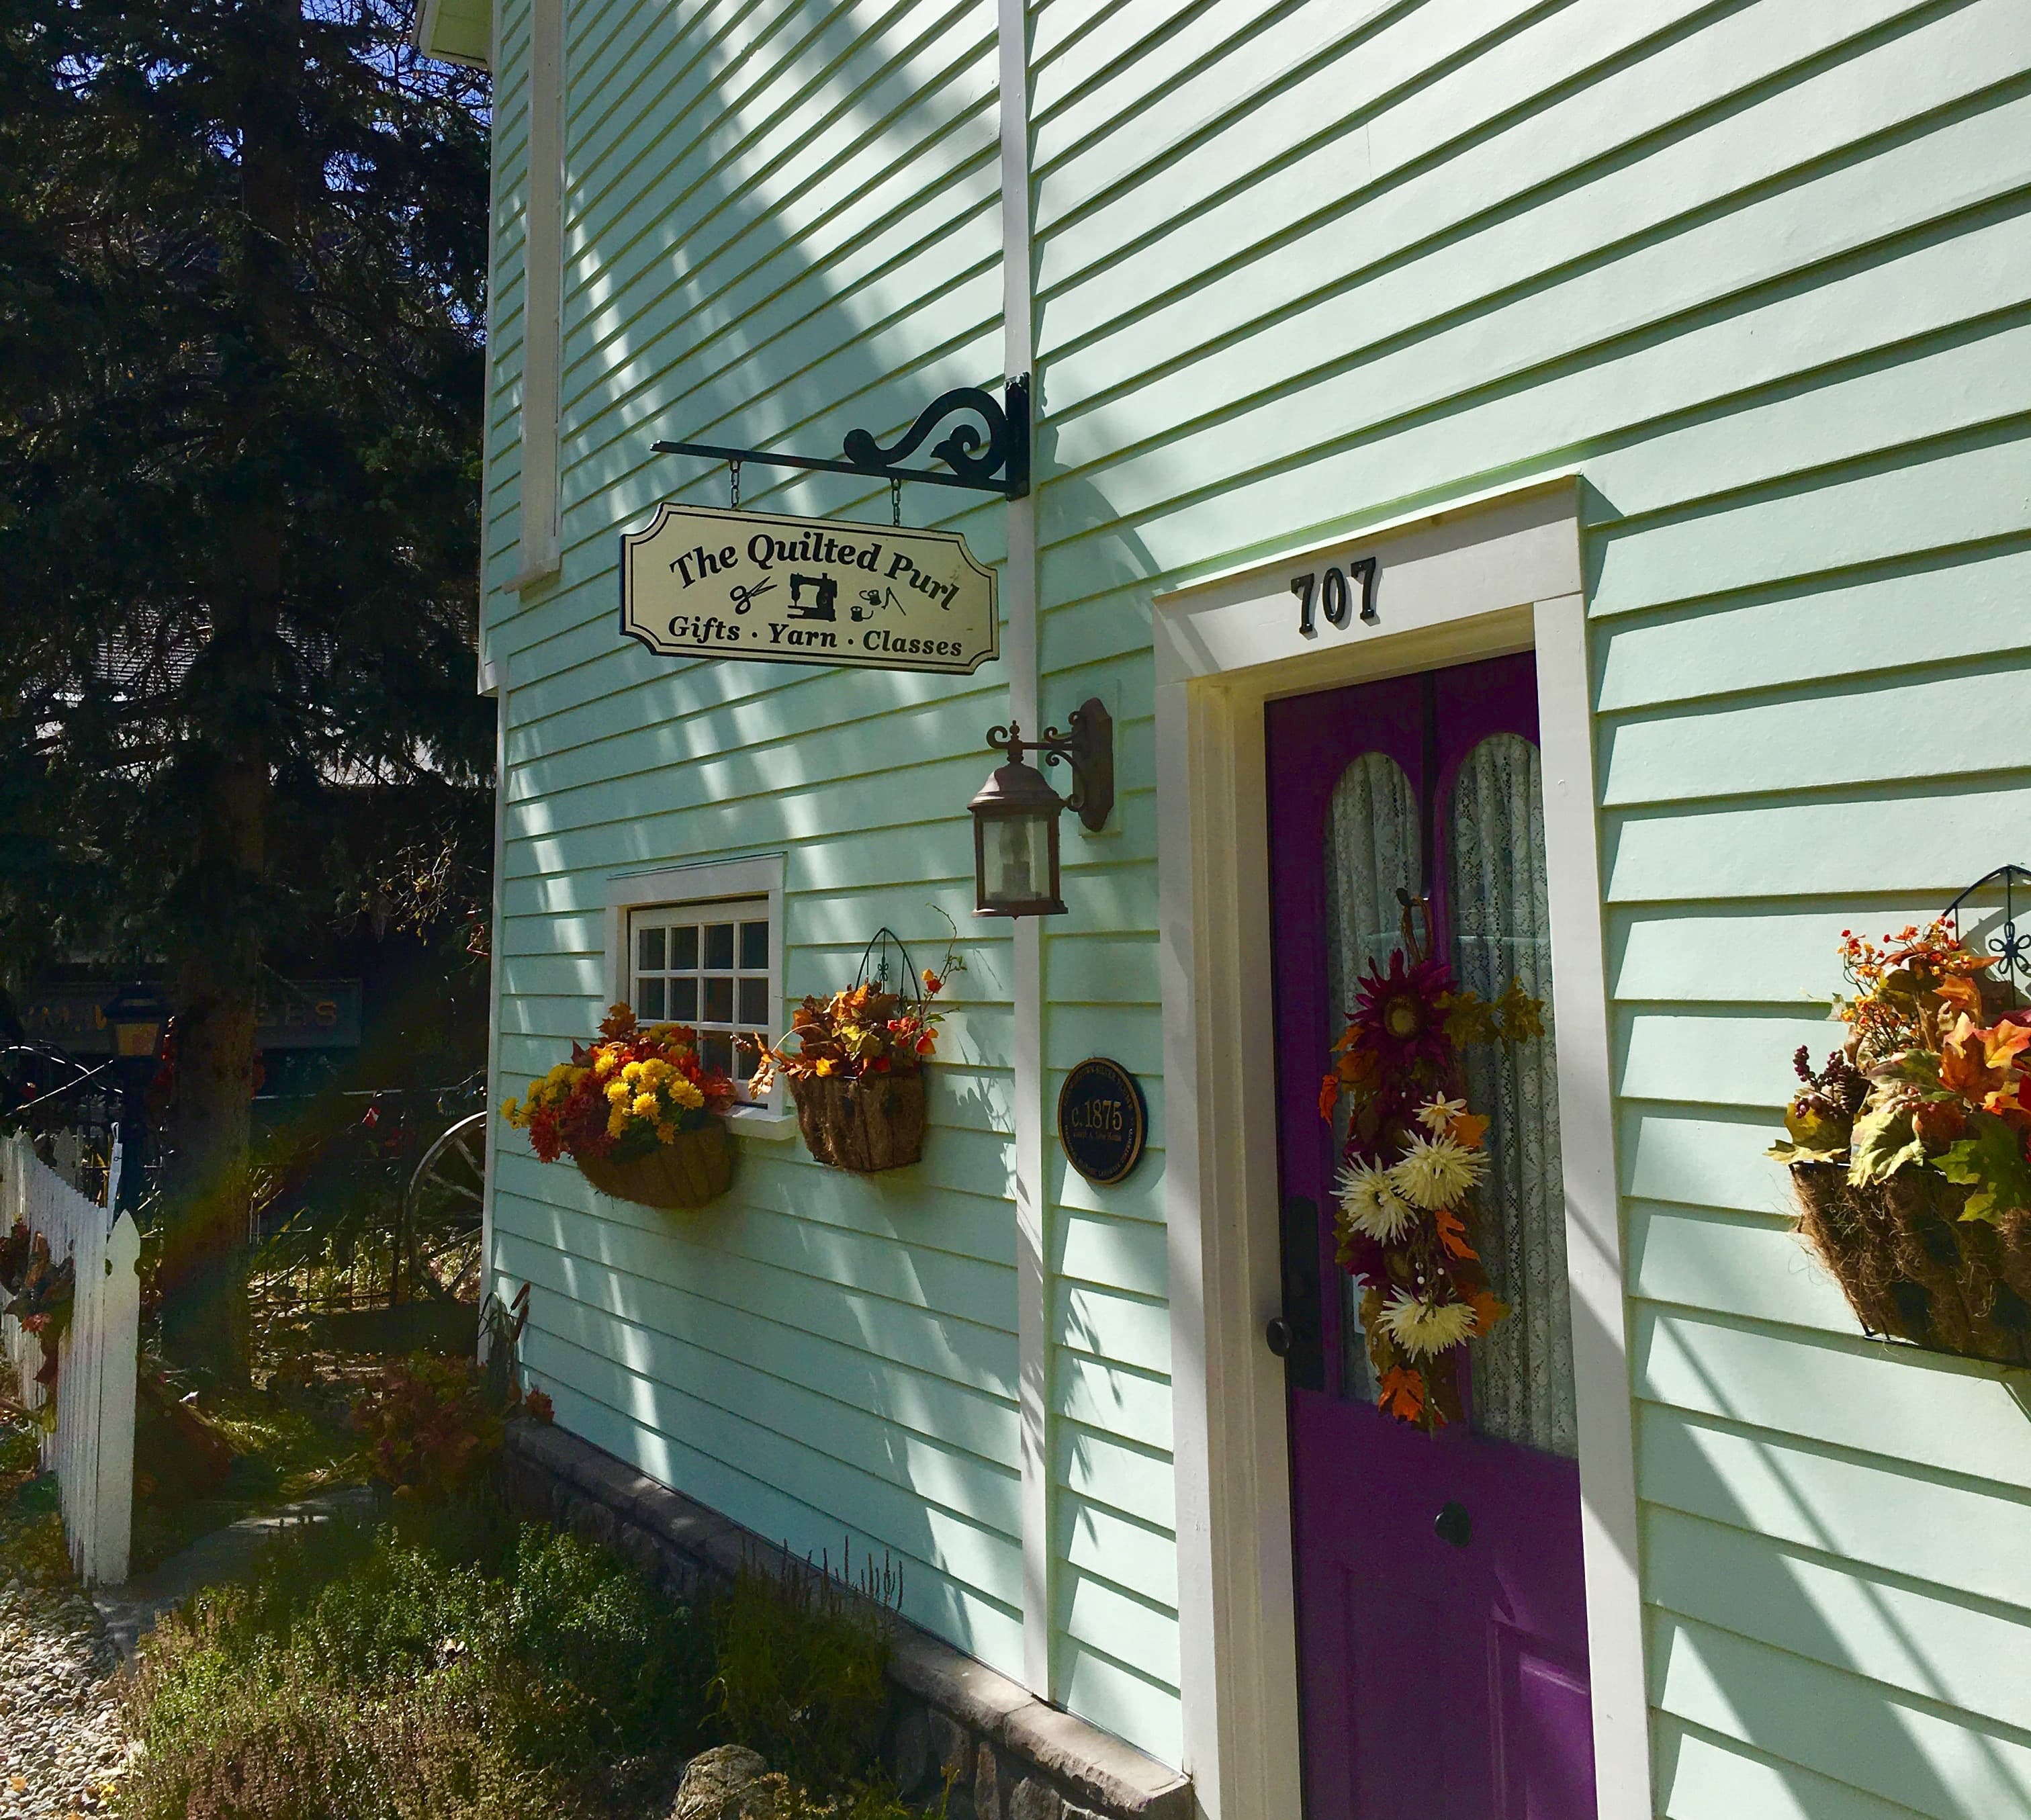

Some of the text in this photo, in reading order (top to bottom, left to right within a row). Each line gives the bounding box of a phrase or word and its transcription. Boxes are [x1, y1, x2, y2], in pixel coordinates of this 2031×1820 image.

[669, 532, 961, 610] The Quilted Purl
[1290, 556, 1376, 633] 707
[668, 615, 963, 656] Gifts Yarn Classes
